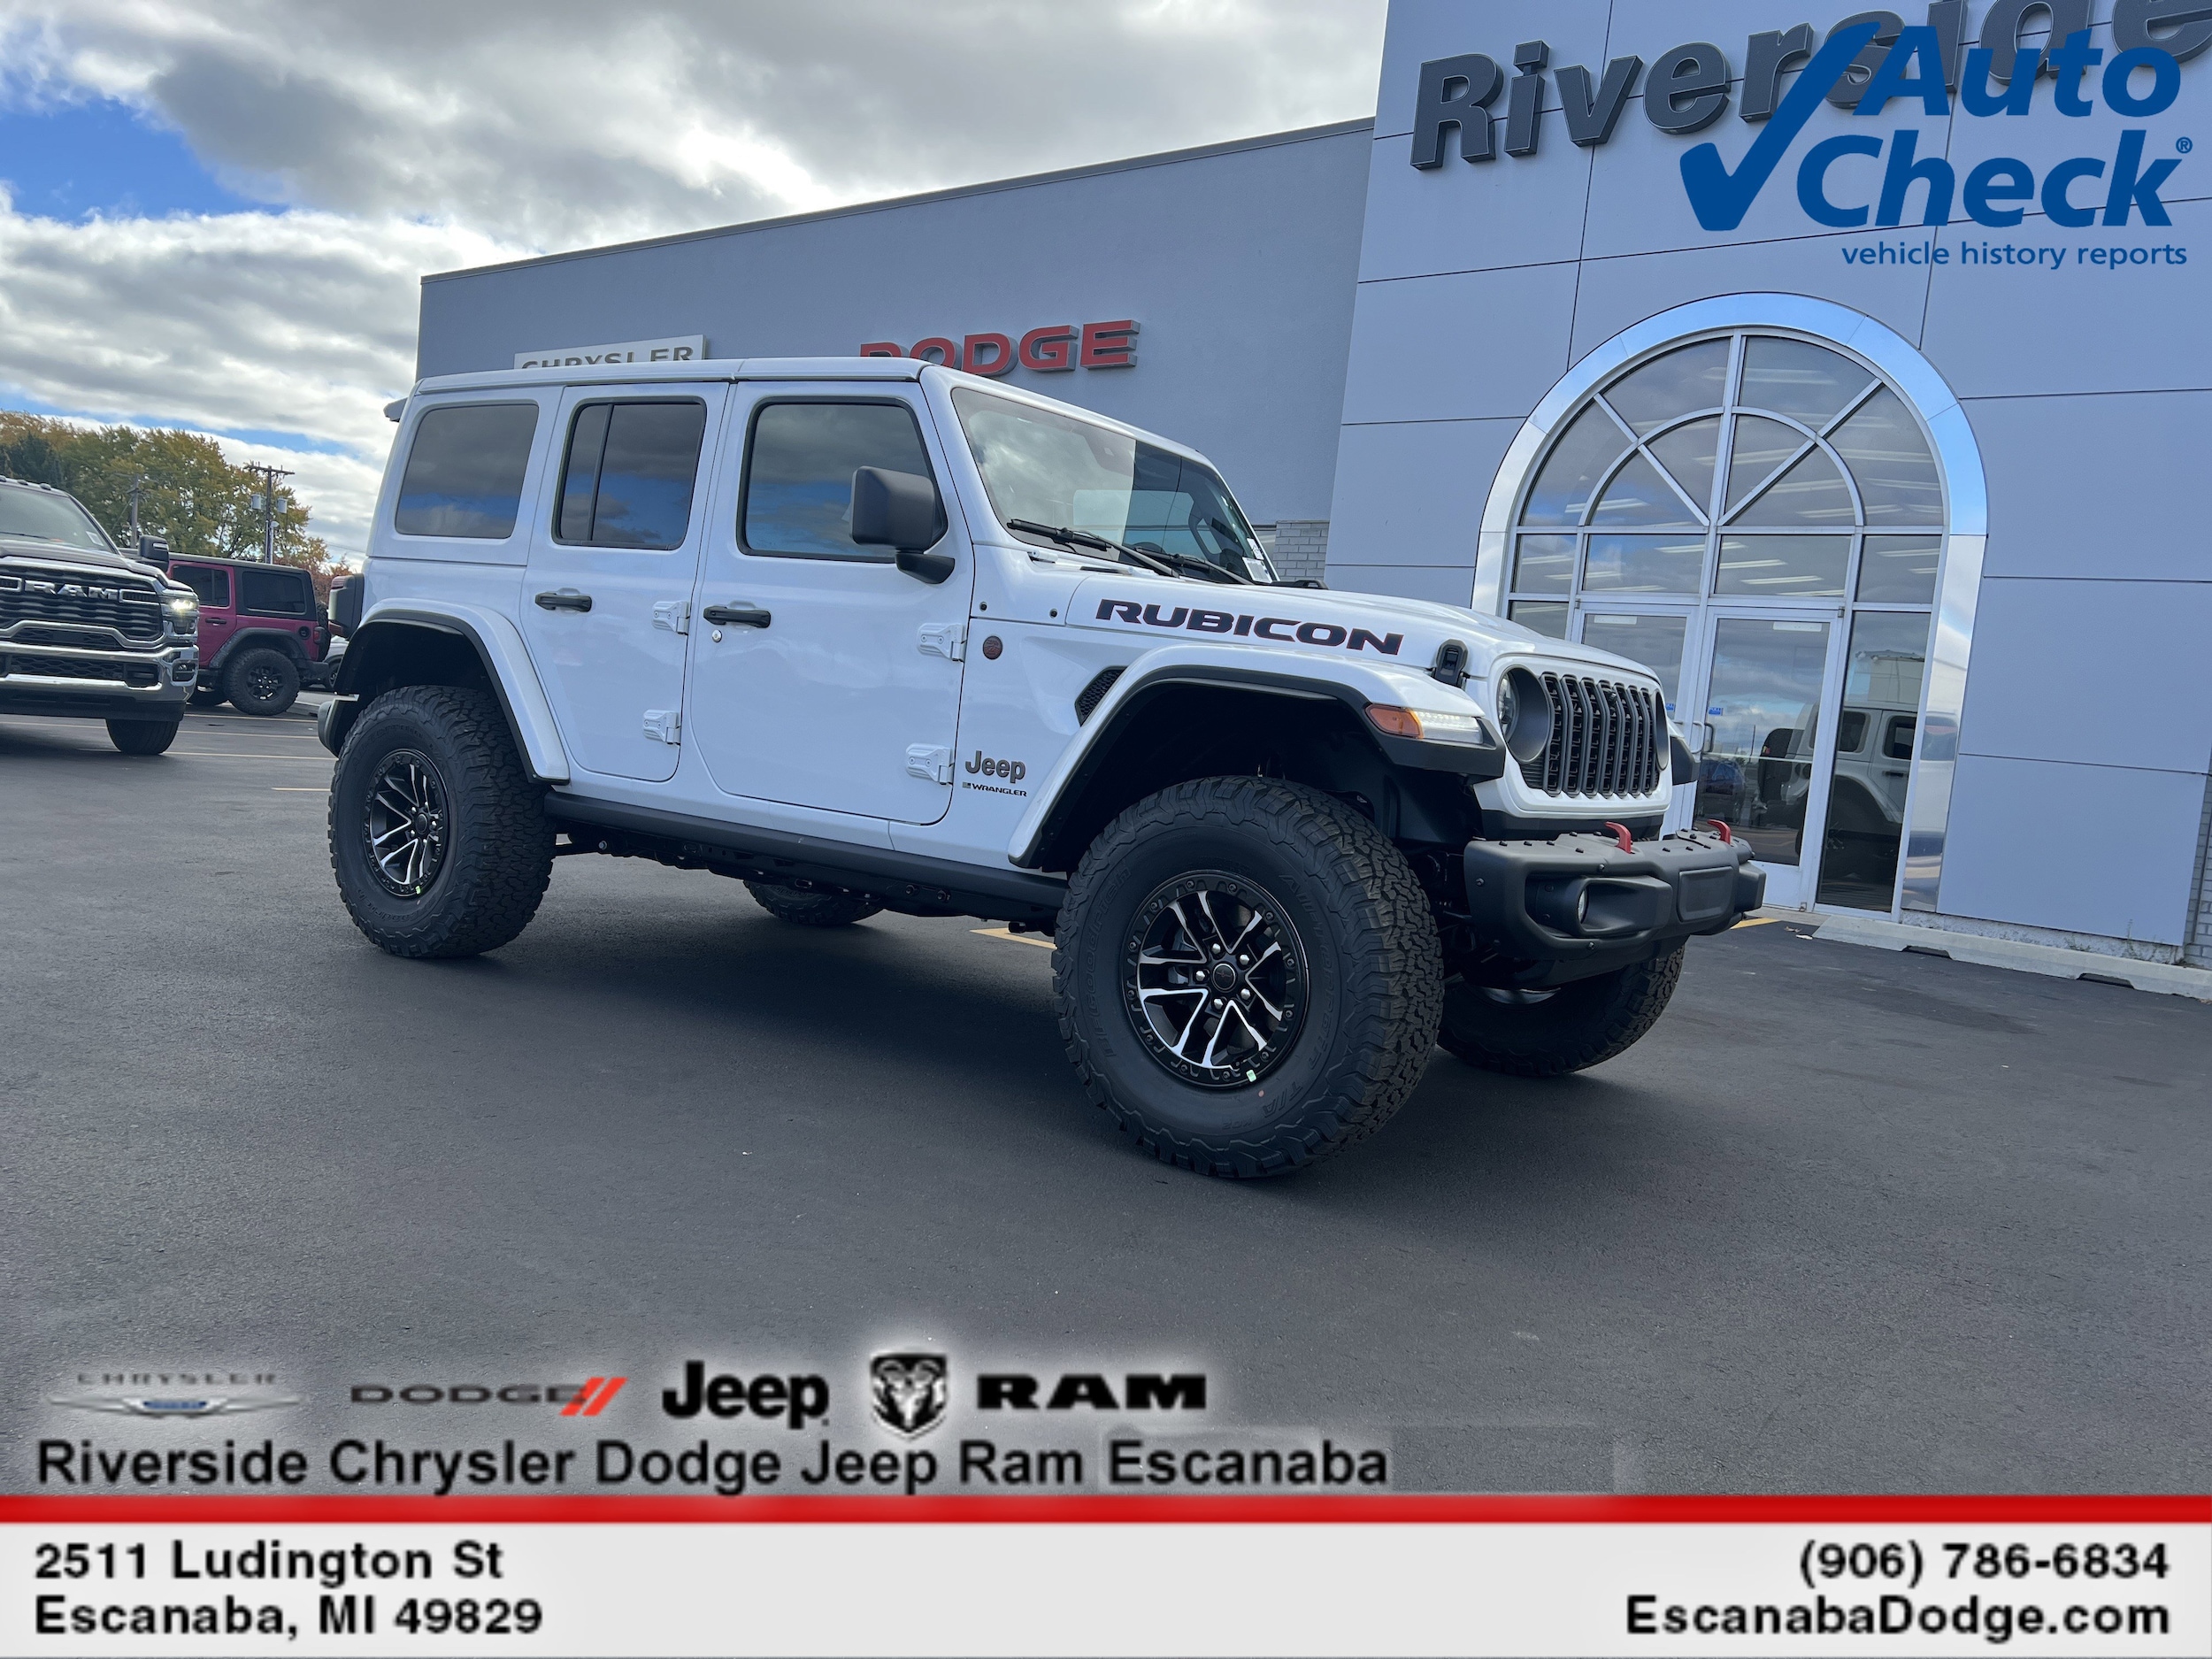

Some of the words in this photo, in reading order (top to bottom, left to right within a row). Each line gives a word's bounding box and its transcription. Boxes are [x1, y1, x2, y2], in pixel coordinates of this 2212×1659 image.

[24, 580, 119, 600] RAM
[1095, 598, 1404, 656] RUBICON
[965, 749, 1025, 784] Jeep
[972, 782, 1027, 796] WRANGLER
